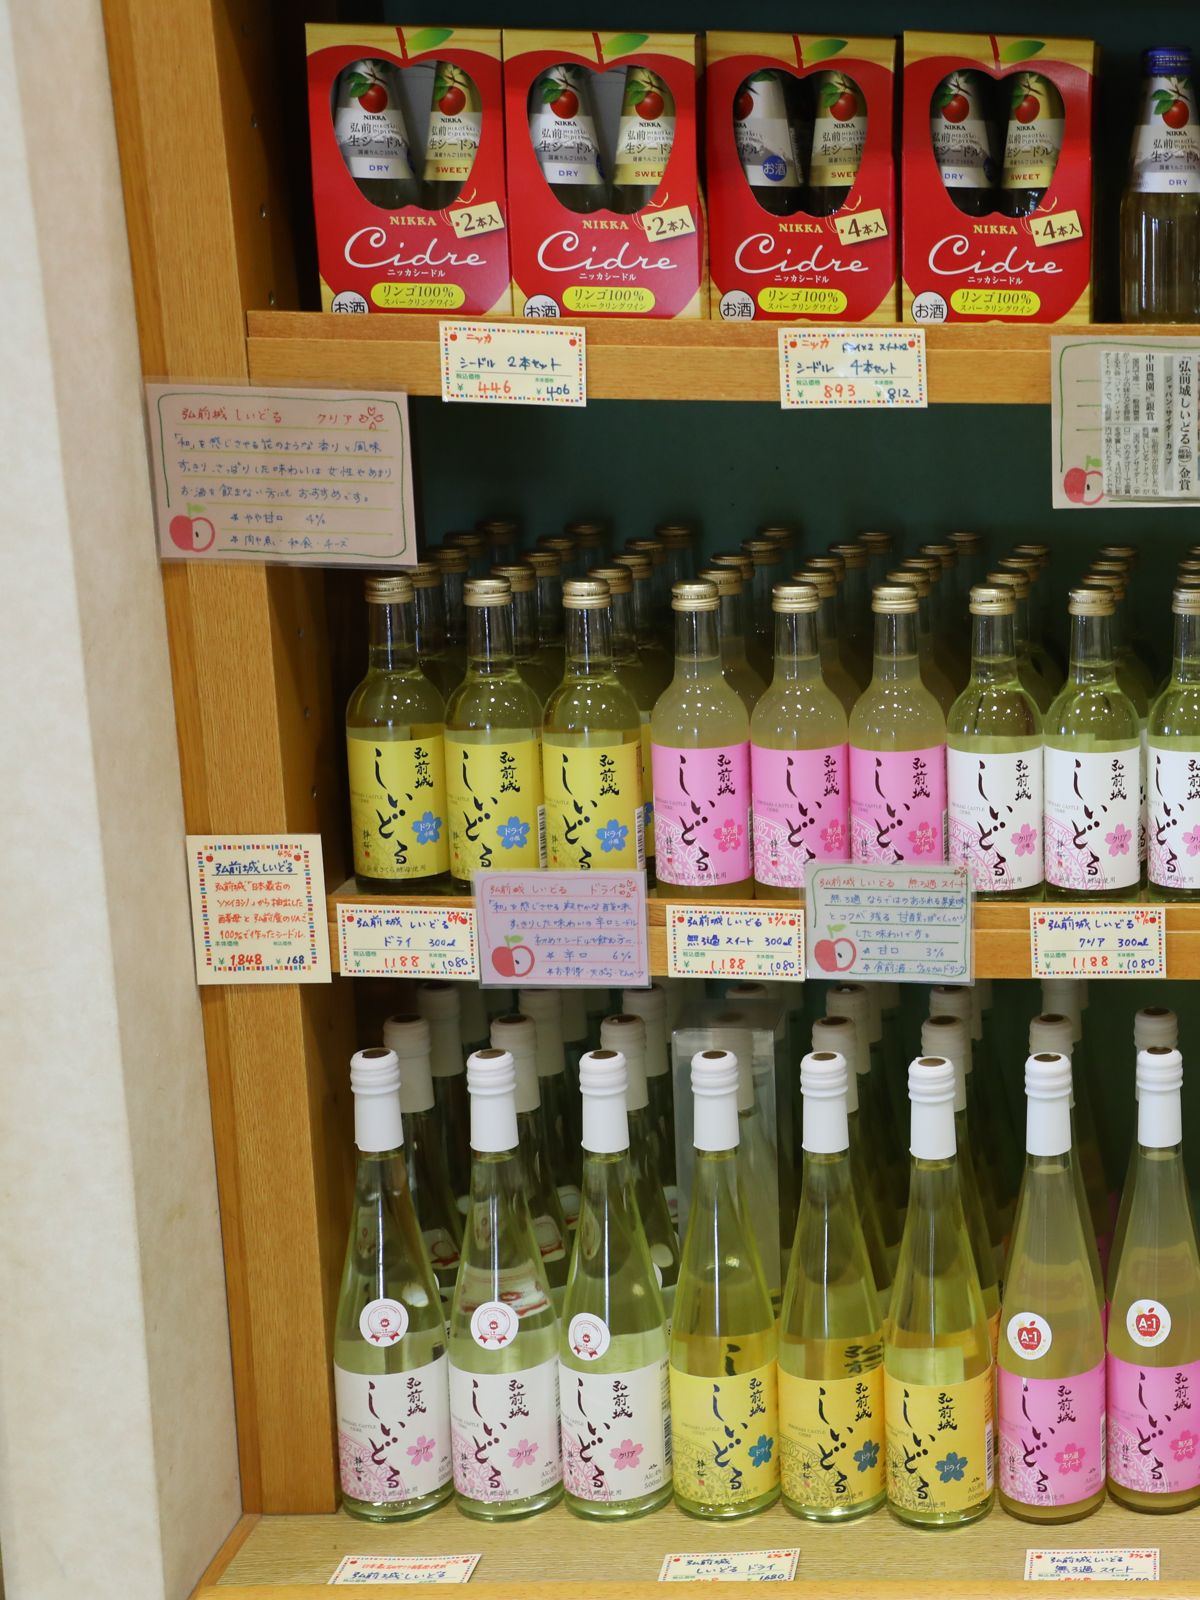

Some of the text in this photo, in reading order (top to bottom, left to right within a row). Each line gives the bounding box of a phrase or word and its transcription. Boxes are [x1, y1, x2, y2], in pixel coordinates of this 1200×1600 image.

[389, 216, 437, 226] NIKKA
[461, 212, 500, 232] 2本入
[582, 220, 629, 230] NIKKA
[654, 215, 690, 236] 2本入
[779, 223, 823, 233] NIKKA
[847, 218, 885, 238] 4本入
[973, 225, 1018, 235] NIKKA
[1043, 219, 1080, 239] 4本入
[343, 226, 487, 269] Cidre
[537, 230, 678, 271] Cidre
[734, 233, 869, 273] Cidre
[928, 235, 1063, 275] Cidre
[387, 268, 446, 278] ニッカシードル
[579, 271, 637, 281] ニッカシードル
[774, 274, 829, 283] ニッカシードル
[968, 276, 1023, 285] ニッカシードル
[722, 300, 752, 318] お酒
[915, 303, 945, 319] お酒
[467, 334, 492, 344] ニッカ
[802, 338, 829, 349] ニッカ
[460, 356, 562, 371] シードル 2本セット
[797, 360, 896, 375] シードル 4本セット
[478, 380, 511, 393] 446
[546, 384, 569, 401] 406
[824, 384, 855, 398] 893
[888, 388, 911, 400] 812
[384, 936, 410, 947] ドライ
[726, 937, 753, 945] スイート
[1139, 1320, 1157, 1329] A-1
[1021, 1332, 1038, 1342] A-1
